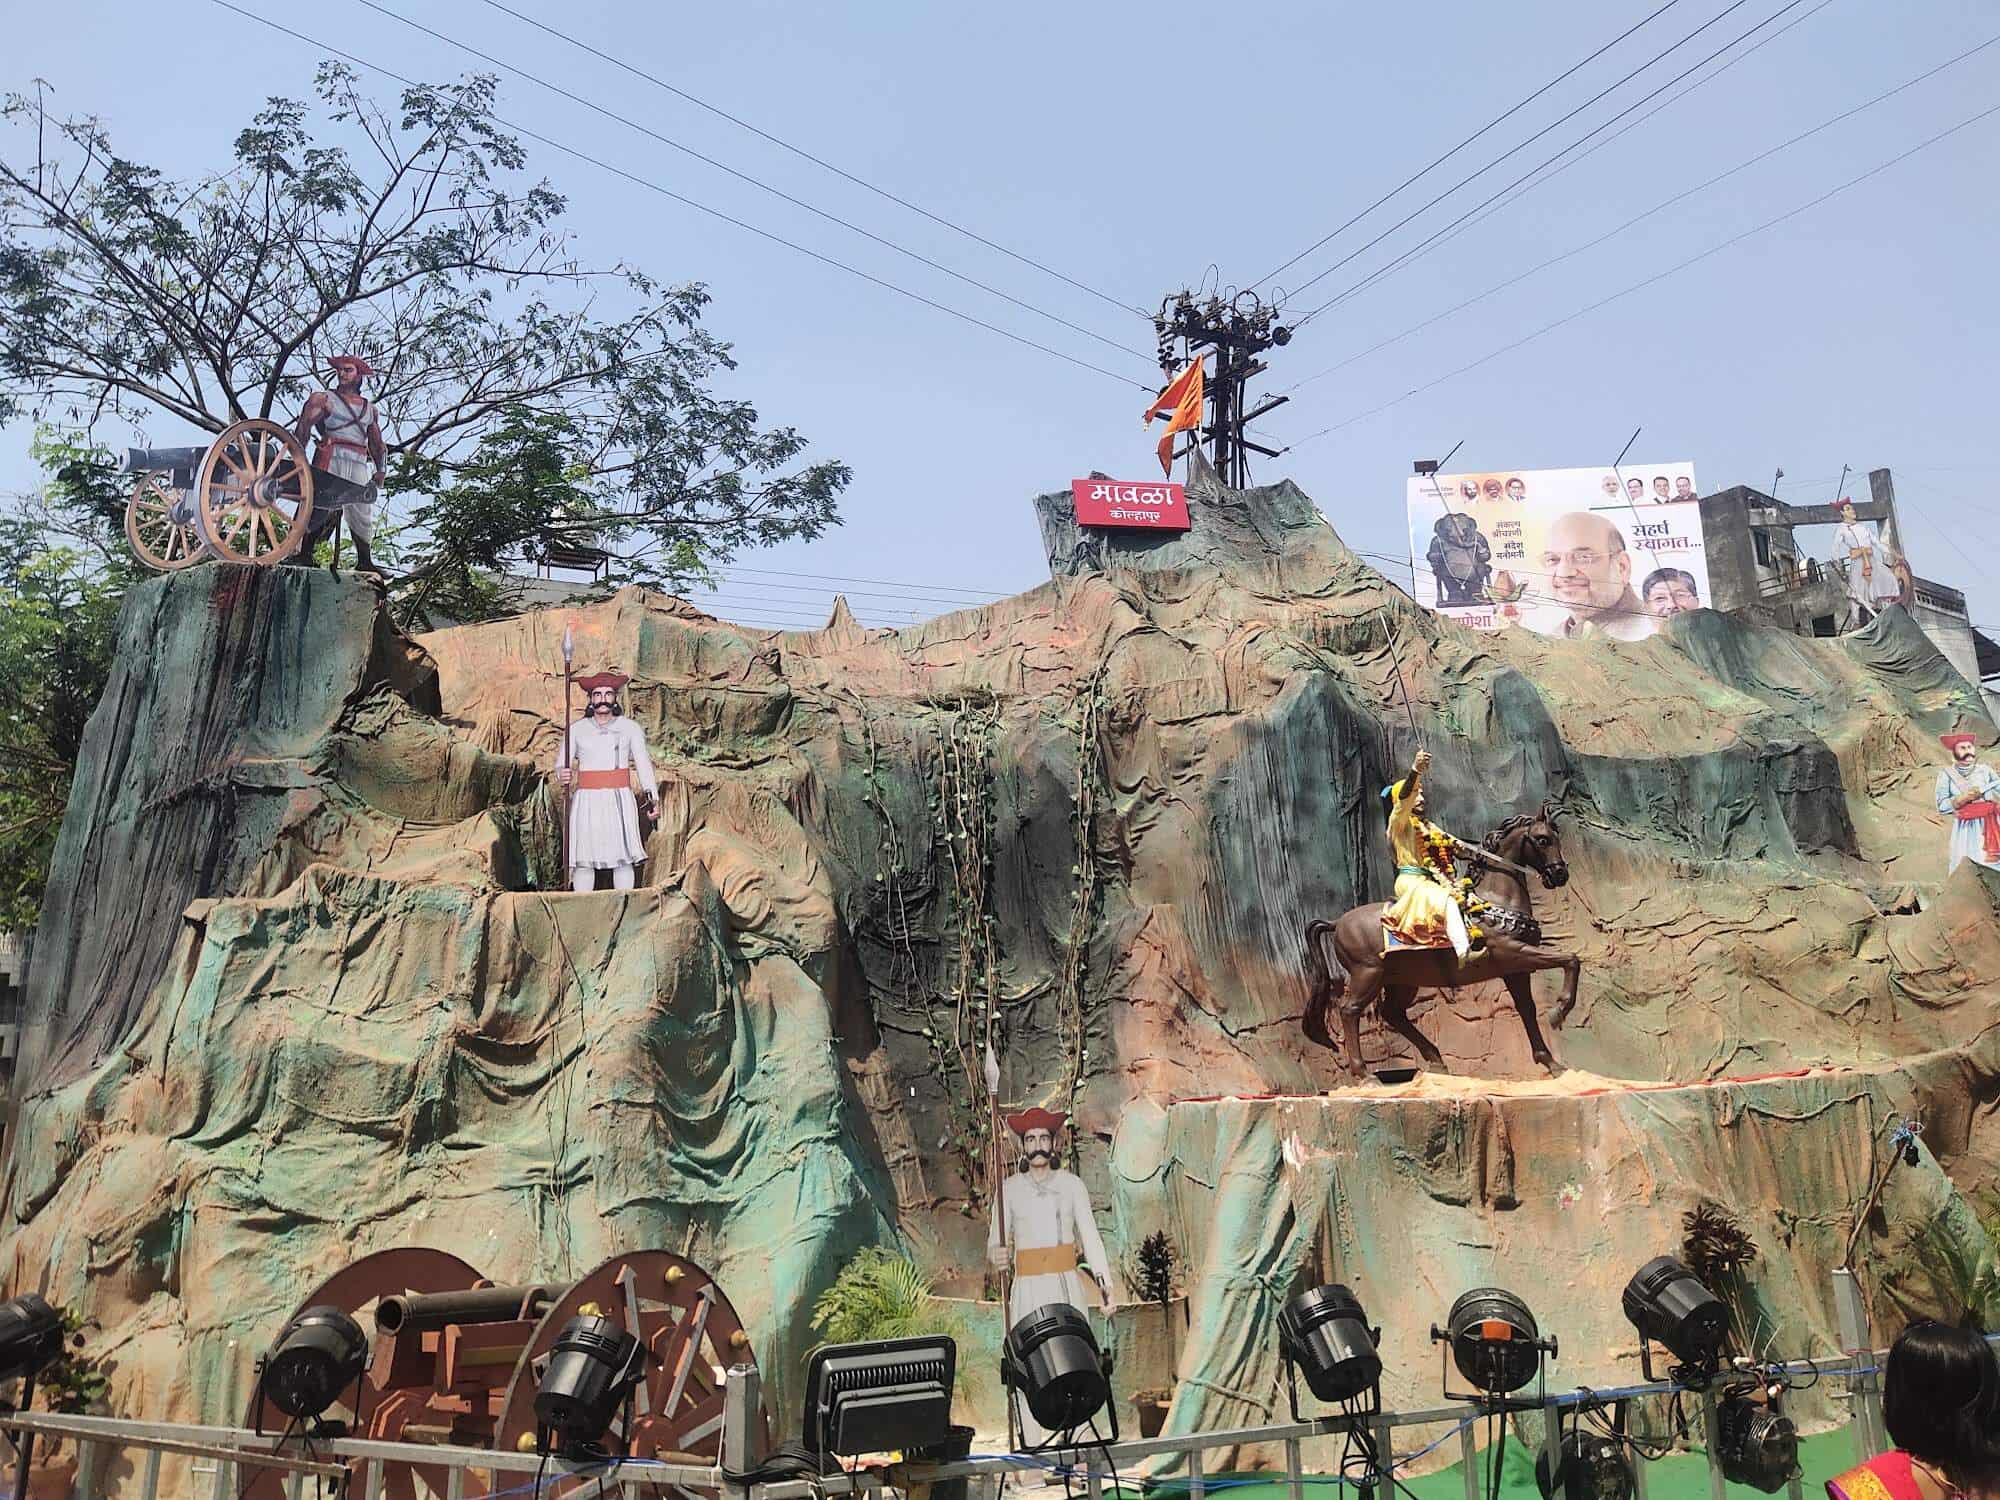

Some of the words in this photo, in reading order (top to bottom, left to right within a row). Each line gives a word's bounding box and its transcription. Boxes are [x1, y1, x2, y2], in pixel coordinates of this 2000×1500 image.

[1088, 484, 1174, 505] मावळा
[1109, 507, 1161, 523] कोल्हापूर
[1632, 519, 1669, 536] सहर्ष
